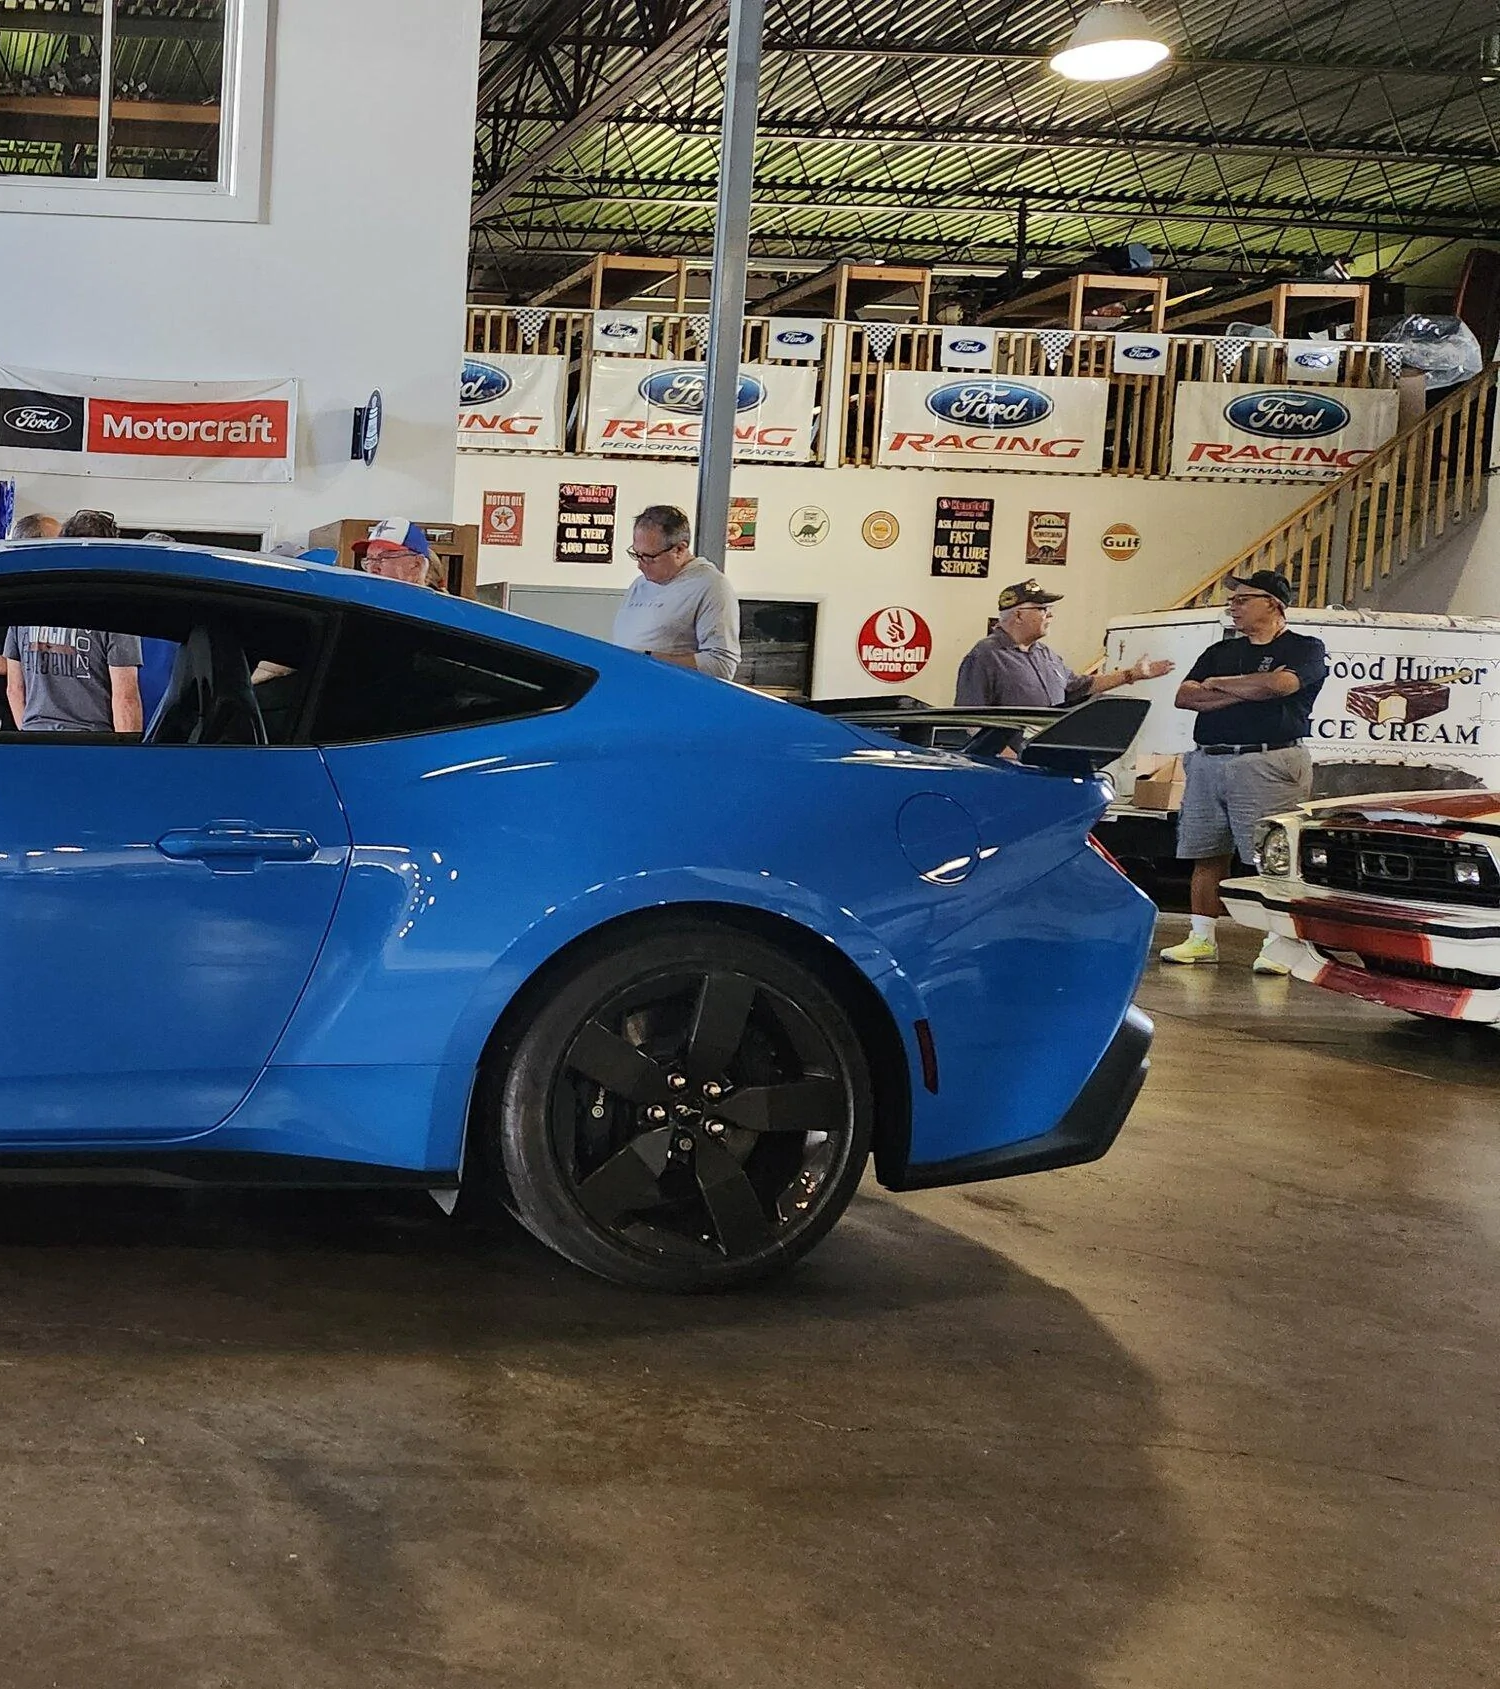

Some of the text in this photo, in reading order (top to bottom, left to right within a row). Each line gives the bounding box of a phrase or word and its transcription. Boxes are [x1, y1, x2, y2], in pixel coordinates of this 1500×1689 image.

[782, 332, 809, 344] Ford
[955, 341, 982, 352] Ford
[1128, 346, 1154, 359] Ford
[951, 386, 1029, 423] Ford
[15, 409, 60, 431] Ford
[1249, 398, 1324, 431] Ford
[601, 419, 798, 447] RACNG
[600, 441, 796, 457] PERFORMA PARTS
[889, 432, 1085, 458] RACING
[1186, 465, 1315, 477] PERFORMANCE
[486, 494, 522, 506] MOTOR OIL
[560, 513, 614, 525] CHANGE YOUR
[937, 519, 990, 530] ASK ABOUT OUR
[565, 528, 606, 540] OIL EVERY
[949, 531, 975, 545] FAST
[560, 542, 609, 554] 3,000 MILES
[1103, 536, 1141, 549] Gulf
[934, 545, 989, 560] OIL & LUBE
[941, 560, 981, 575] SERVICE
[76, 629, 91, 679] 021
[862, 645, 926, 662] Kendall
[868, 662, 918, 673] MOTOR OIL
[1395, 656, 1488, 685] Humor
[1306, 718, 1482, 745] ICE CREAM
